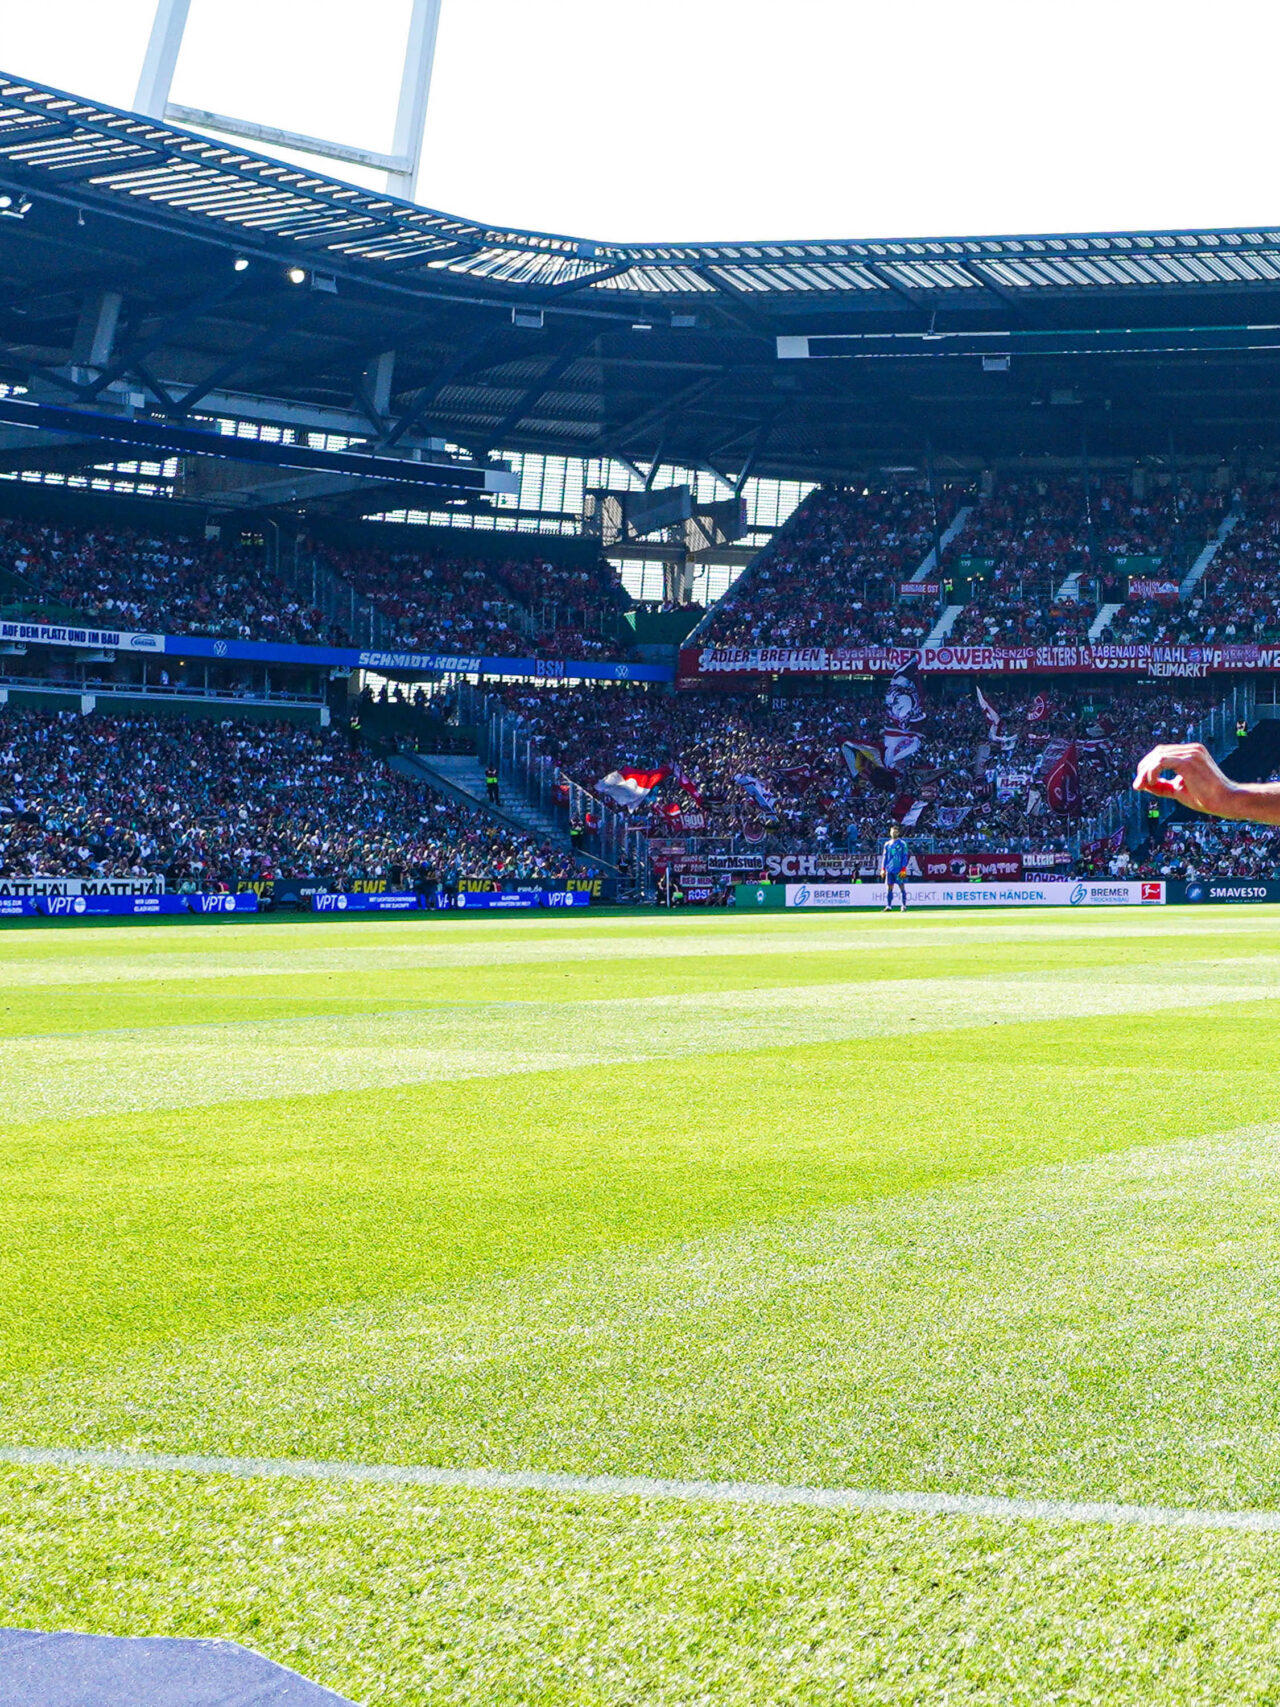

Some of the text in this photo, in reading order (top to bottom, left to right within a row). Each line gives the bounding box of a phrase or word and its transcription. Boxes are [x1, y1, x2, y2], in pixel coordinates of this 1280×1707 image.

[2, 624, 18, 637] AUF
[20, 625, 39, 639] DEM
[41, 627, 66, 641] PLATZ
[68, 629, 86, 643] UND
[88, 631, 99, 644] IM
[101, 632, 120, 646] BAU
[710, 649, 820, 662] ADLER BRETTEN
[925, 648, 993, 665] POWER
[1037, 648, 1077, 667] SELTERS
[537, 659, 565, 677] BSN
[1148, 662, 1209, 677] NEUMARKT
[0, 882, 67, 895] ATTHÄI
[354, 880, 387, 893] EWE
[458, 880, 491, 892] EWE
[566, 879, 602, 896] EWE
[1091, 888, 1129, 896] BREMER
[1210, 887, 1267, 897] SMAVESTO
[548, 893, 566, 906] VPT
[814, 890, 850, 898] BREMER
[943, 891, 953, 900] IN
[956, 891, 997, 900] BESTEN
[1000, 889, 1046, 900] HÄNDEN.
[48, 897, 74, 913] VPT
[201, 896, 227, 911] VPT
[316, 895, 338, 910] VPT
